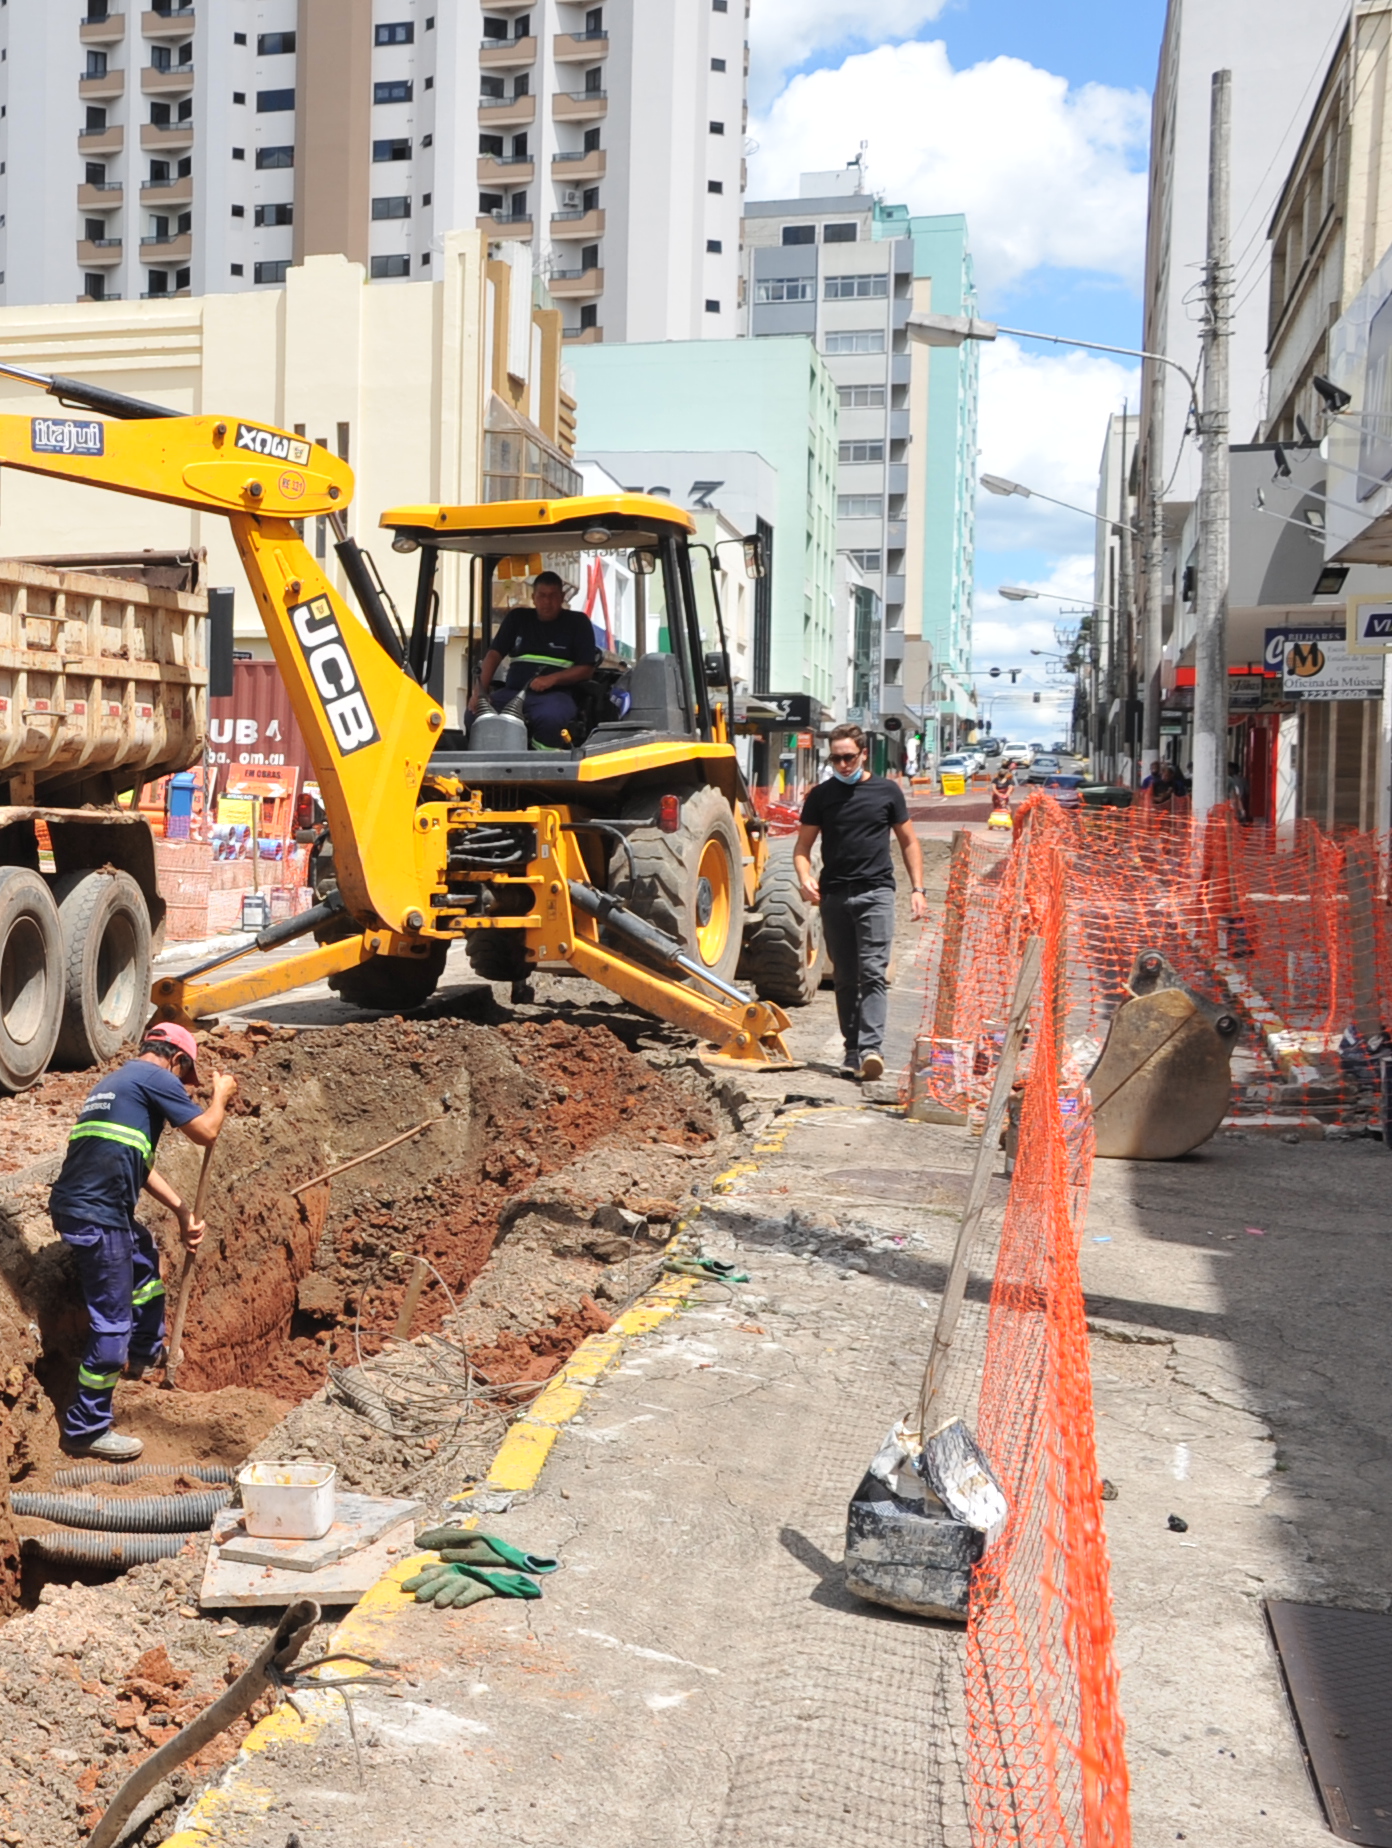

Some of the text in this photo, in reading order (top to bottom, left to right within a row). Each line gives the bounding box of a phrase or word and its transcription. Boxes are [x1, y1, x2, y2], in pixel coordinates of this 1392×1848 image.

[34, 419, 101, 453] itajui
[237, 425, 290, 459] 3CX
[1373, 618, 1392, 633] VI
[1288, 633, 1341, 641] BILHARES
[293, 605, 374, 750] JCB
[1284, 678, 1325, 689] Oficina
[1326, 678, 1339, 688] da
[1341, 676, 1383, 688] Música
[244, 769, 282, 780] EM OBRAS
